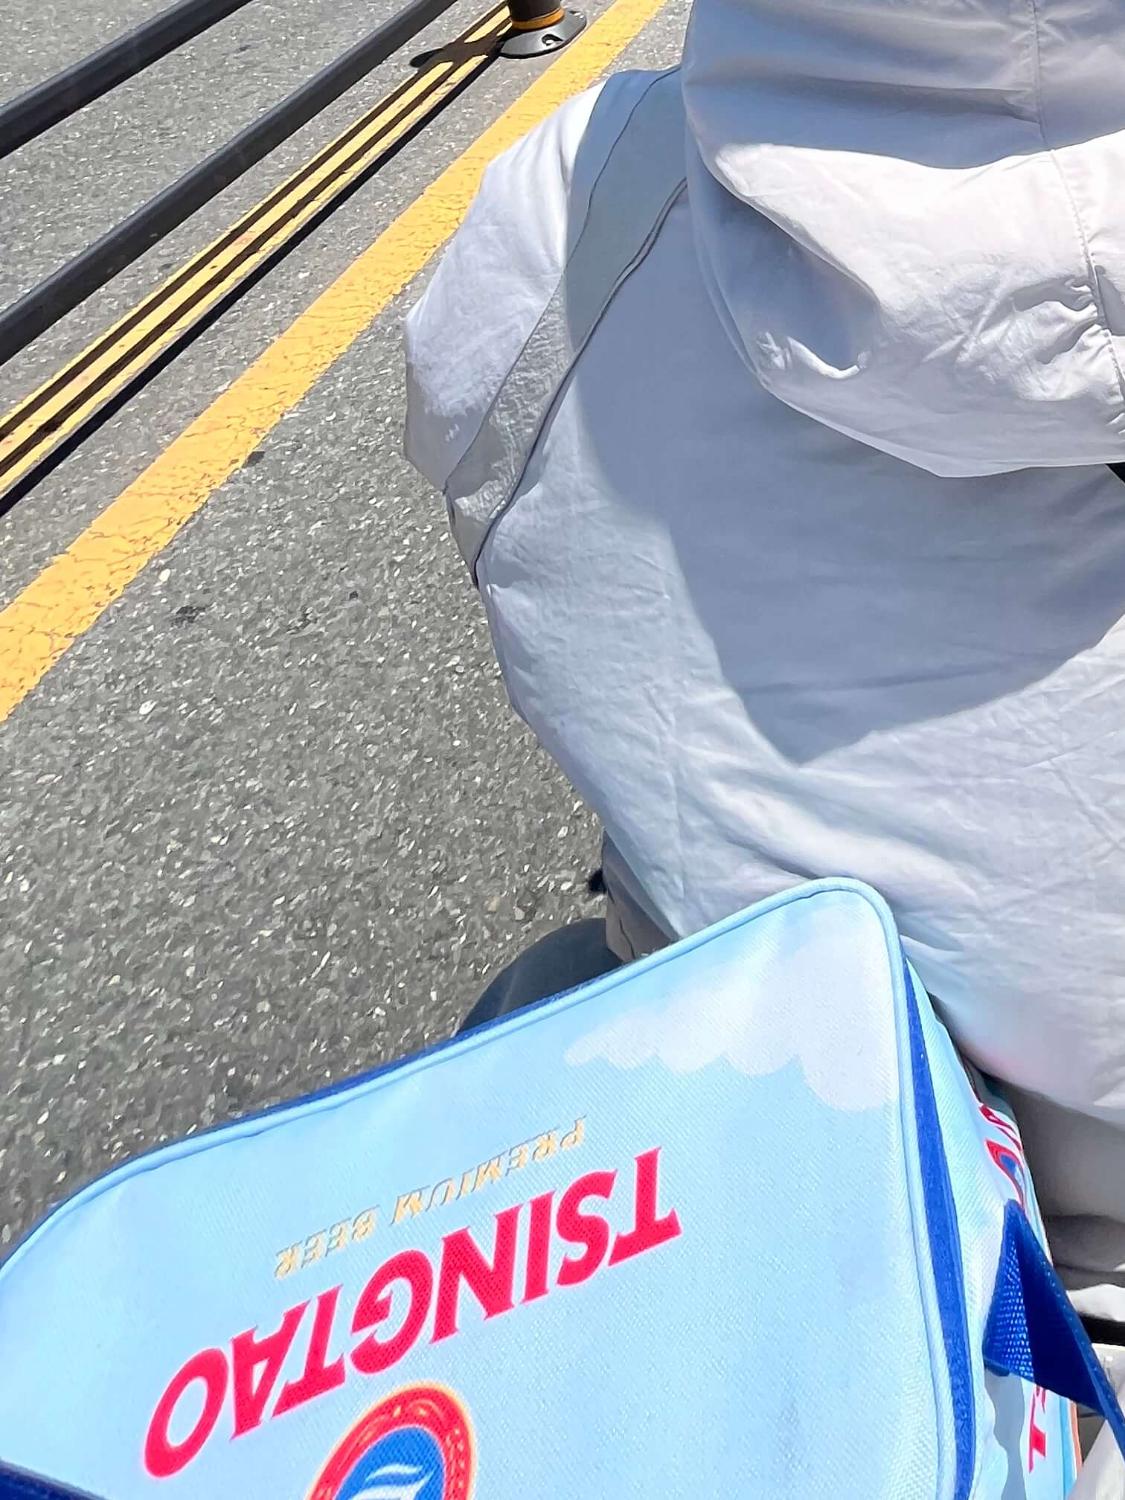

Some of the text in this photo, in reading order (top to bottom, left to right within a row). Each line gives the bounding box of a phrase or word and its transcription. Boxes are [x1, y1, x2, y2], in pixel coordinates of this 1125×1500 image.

[143, 1146, 682, 1479] TSINGTAO
[275, 1114, 587, 1280] PREMIUM BEER
